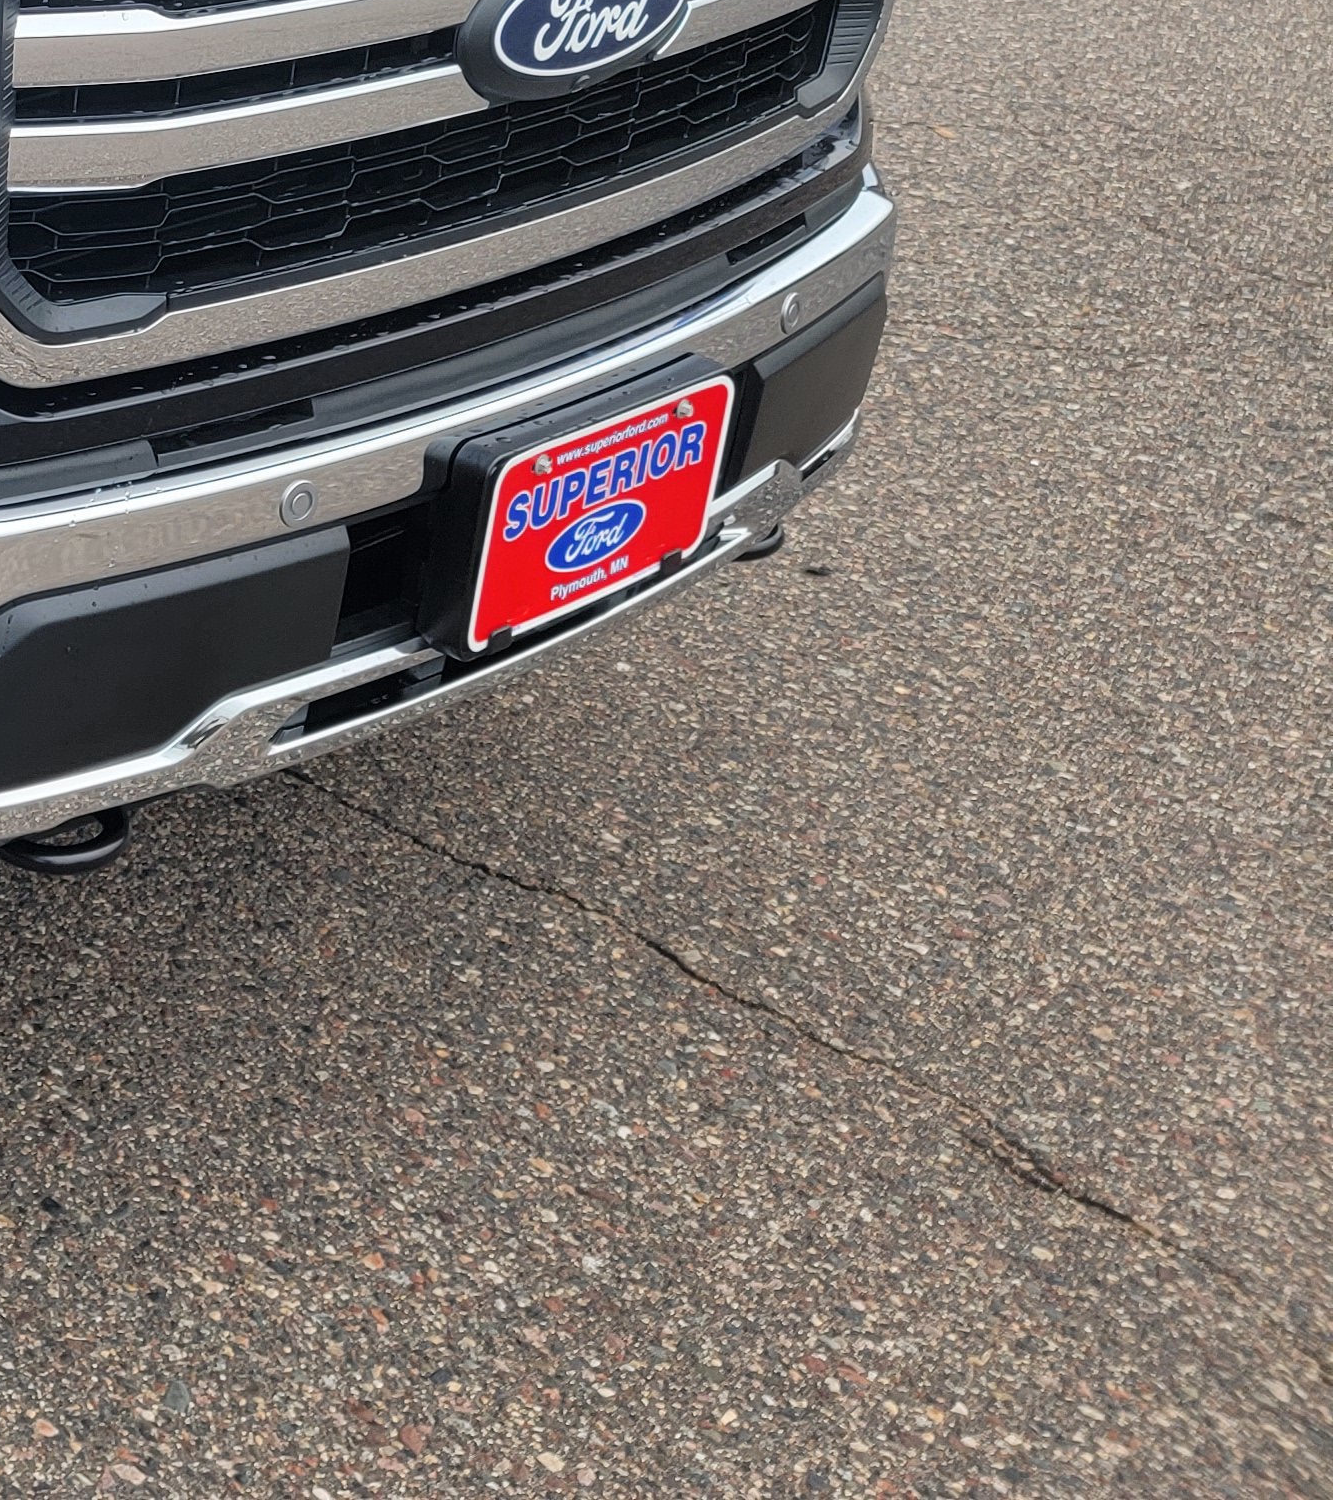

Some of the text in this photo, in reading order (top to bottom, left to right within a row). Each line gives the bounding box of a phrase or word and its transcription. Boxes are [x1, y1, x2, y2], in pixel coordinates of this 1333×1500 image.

[557, 413, 669, 465] www.superiorford.com
[503, 421, 707, 542] SUPERIOR
[565, 510, 629, 562] Ford
[550, 555, 630, 601] Plymouth, MN
